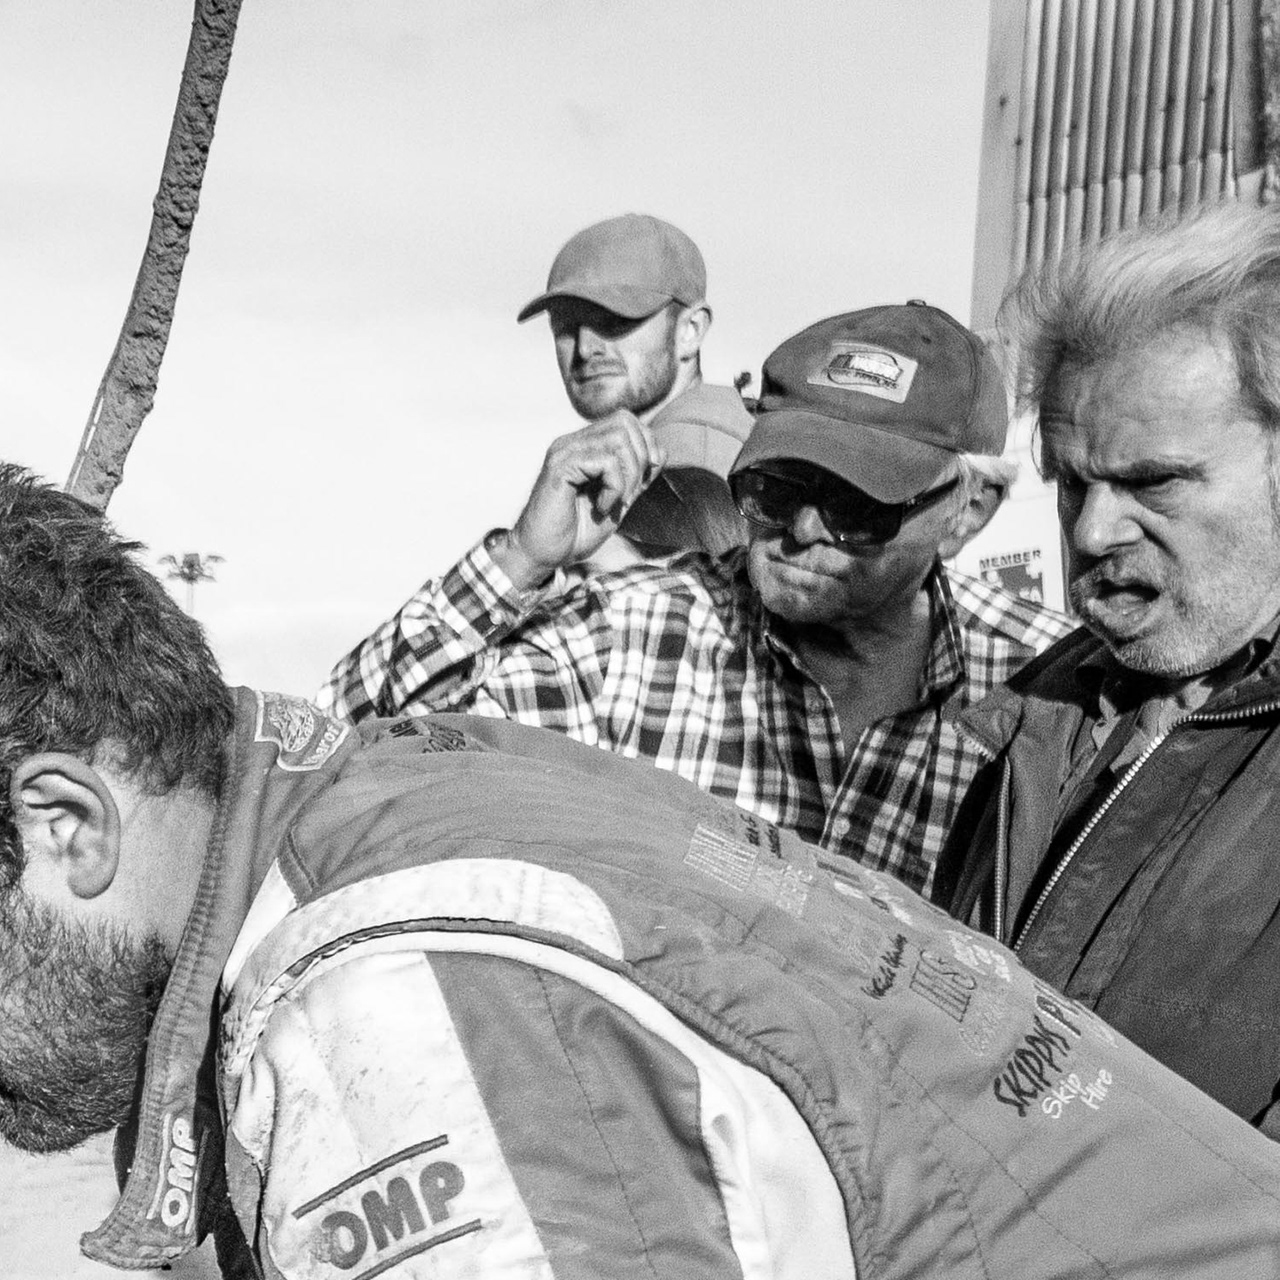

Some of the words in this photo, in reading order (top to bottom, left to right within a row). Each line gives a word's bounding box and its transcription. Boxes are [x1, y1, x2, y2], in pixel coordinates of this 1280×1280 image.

[979, 549, 1041, 569] MEMBER
[1042, 1073, 1087, 1119] Skip
[161, 1116, 196, 1228] OMP
[316, 1160, 466, 1271] OMP
